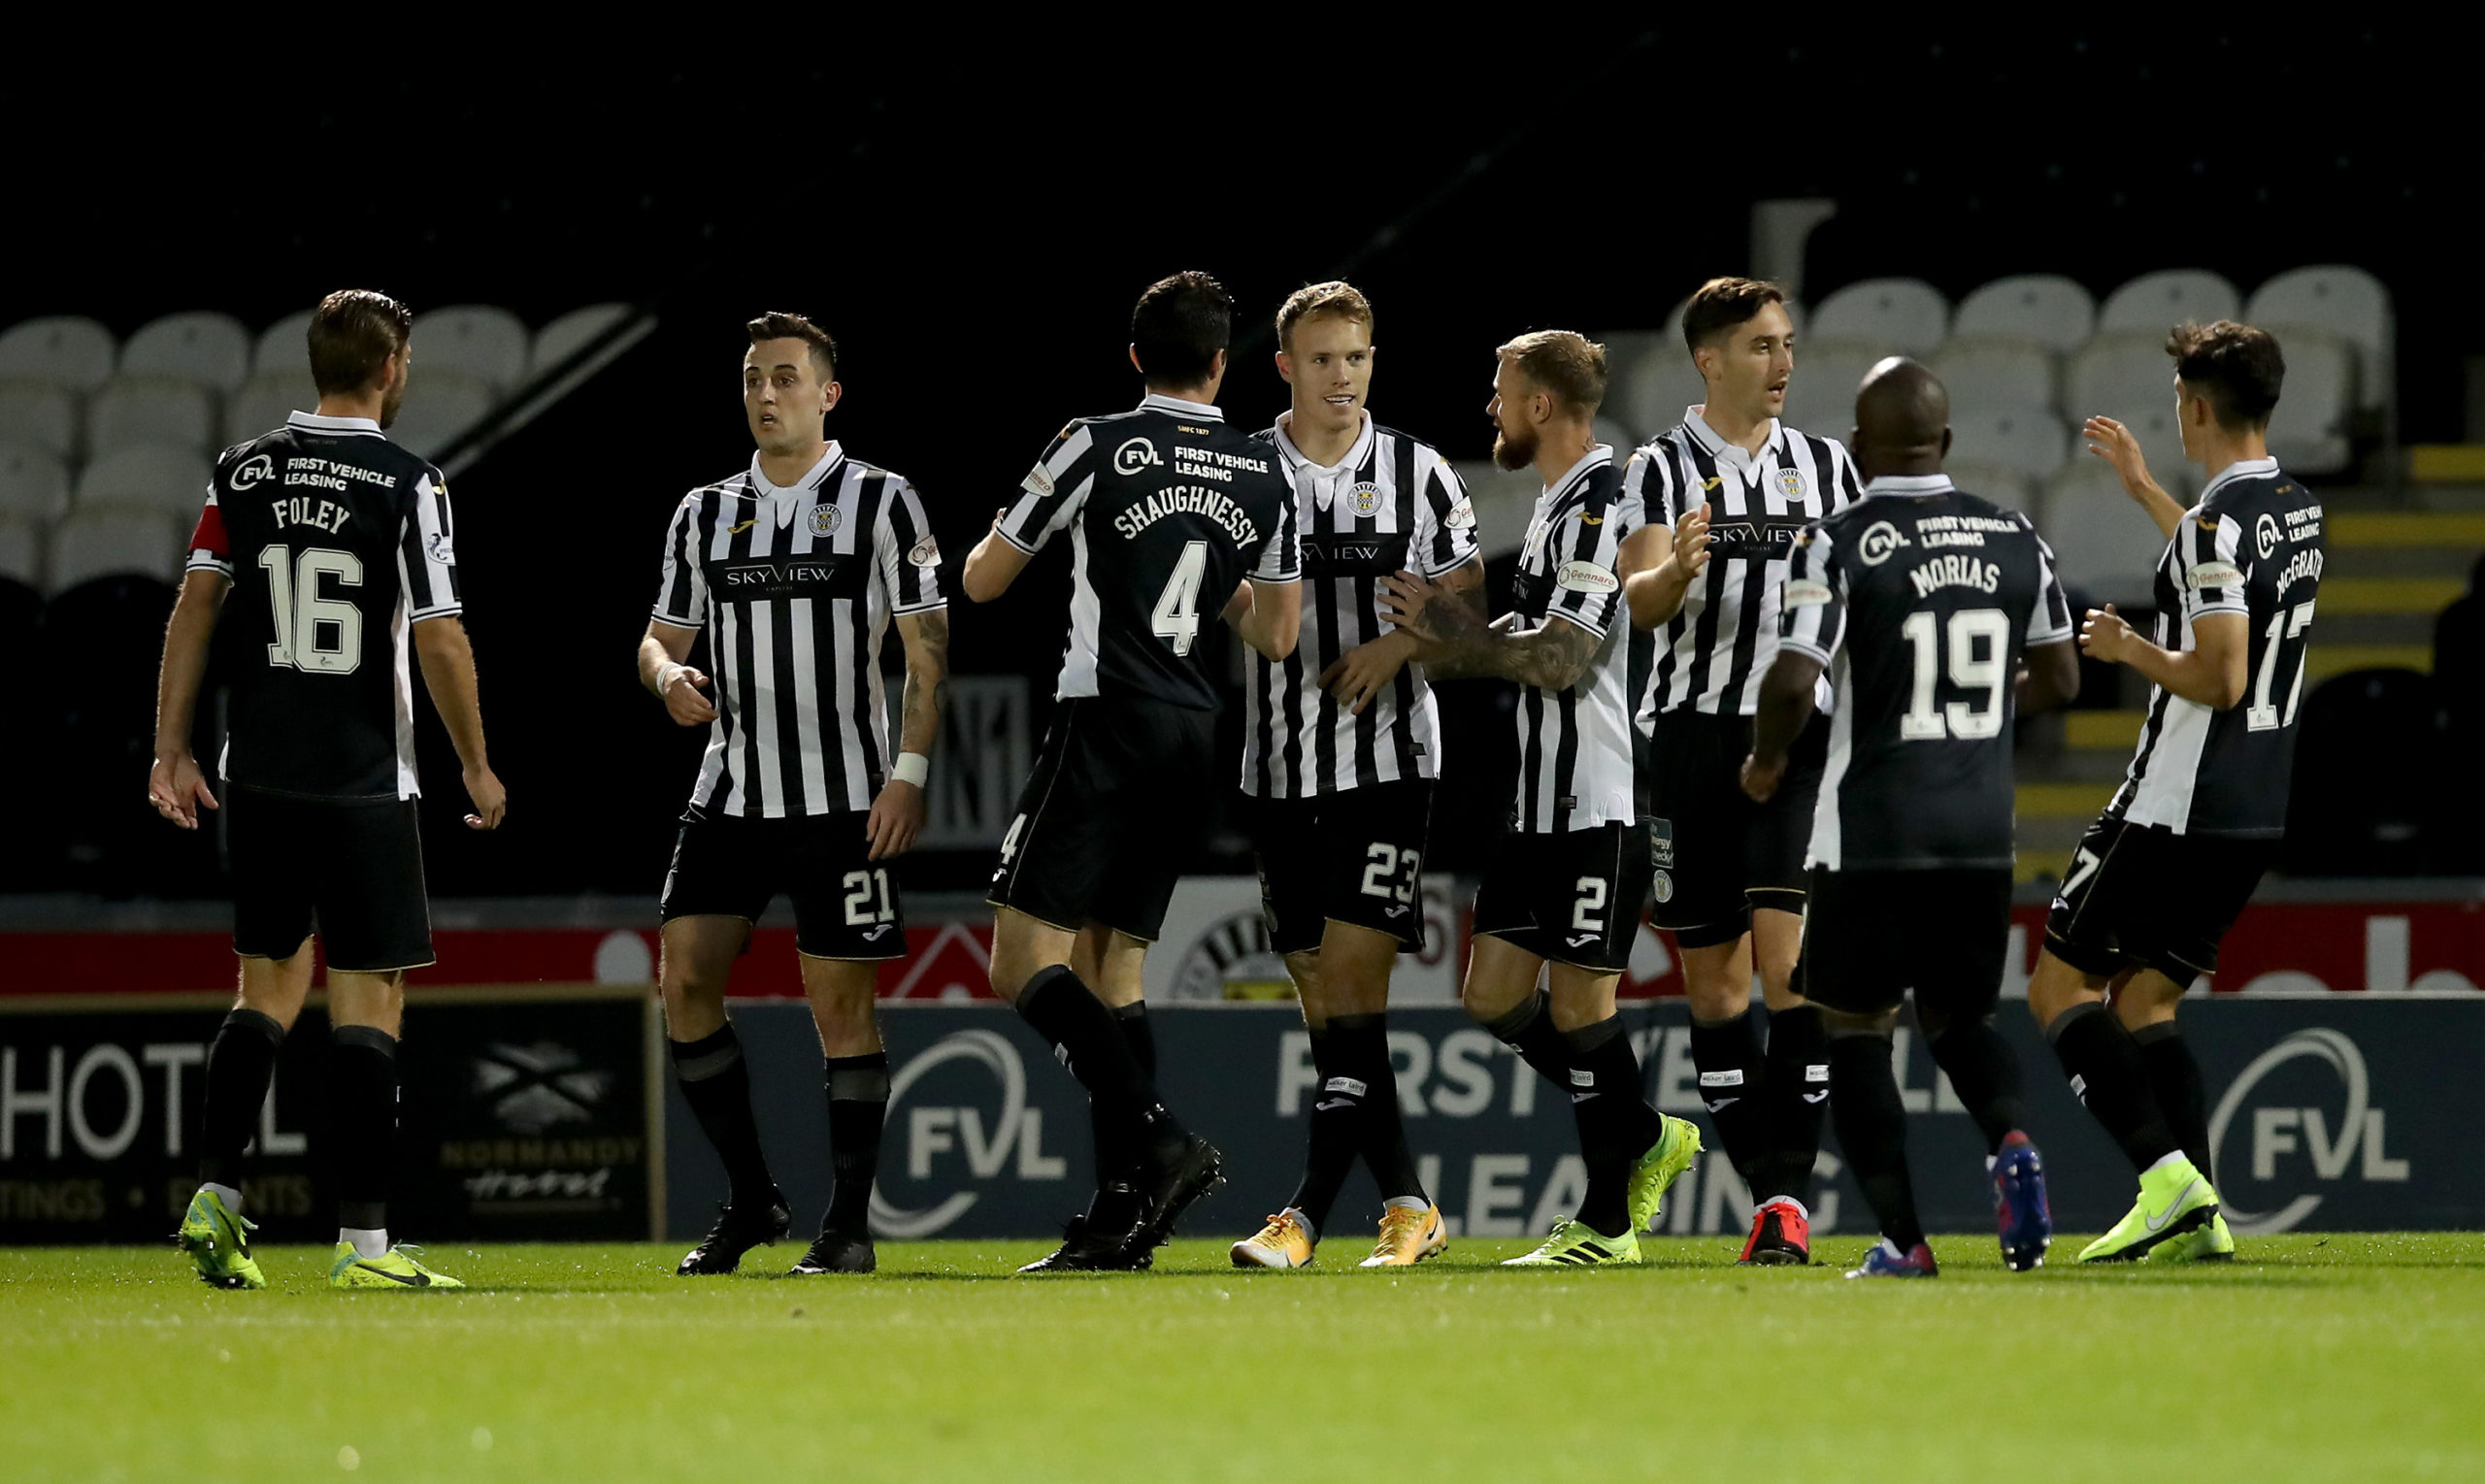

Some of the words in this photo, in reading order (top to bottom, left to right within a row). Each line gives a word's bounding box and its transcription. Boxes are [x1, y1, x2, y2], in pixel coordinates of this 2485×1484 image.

[243, 463, 276, 480] FVL
[287, 457, 328, 472] FIRST
[329, 461, 396, 488] VEHICLE
[1126, 450, 1164, 466] FVL
[1175, 446, 1214, 463] FIRST
[1215, 452, 1269, 474] VEHICLE
[1176, 461, 1233, 482] LEASING
[284, 473, 348, 491] LEASING
[272, 497, 350, 534] FOLEY
[1114, 485, 1258, 550] SHAUGHNESSY
[1915, 515, 1958, 533] FIRST
[1958, 516, 2020, 533] VEHICLE
[2284, 509, 2306, 527] FIRST
[2289, 522, 2319, 543] LEASING
[1302, 543, 1378, 561] YVIEW
[1869, 531, 1911, 553] FVL
[1921, 532, 1986, 549] LEASING
[2261, 526, 2284, 546] FVL
[727, 562, 835, 585] SKYVIEW
[1571, 569, 1614, 585] Gennaro
[1908, 553, 2001, 599] MORIAS
[258, 544, 363, 675] 16
[1151, 540, 1208, 657] 4
[1901, 608, 2010, 740] 19
[2246, 598, 2316, 733] 17
[1000, 812, 1028, 866] 4
[1361, 841, 1421, 905] 23
[2059, 842, 2101, 898] 7
[844, 868, 895, 925] 21
[1572, 875, 1607, 931] 2
[1276, 1030, 1537, 1117] FRST
[2, 1042, 307, 1161] HOTL
[439, 1137, 644, 1169] NORMANDY
[908, 1107, 1066, 1181] FVL
[2252, 1106, 2411, 1182] FVL
[1412, 1154, 1842, 1237] LEAING
